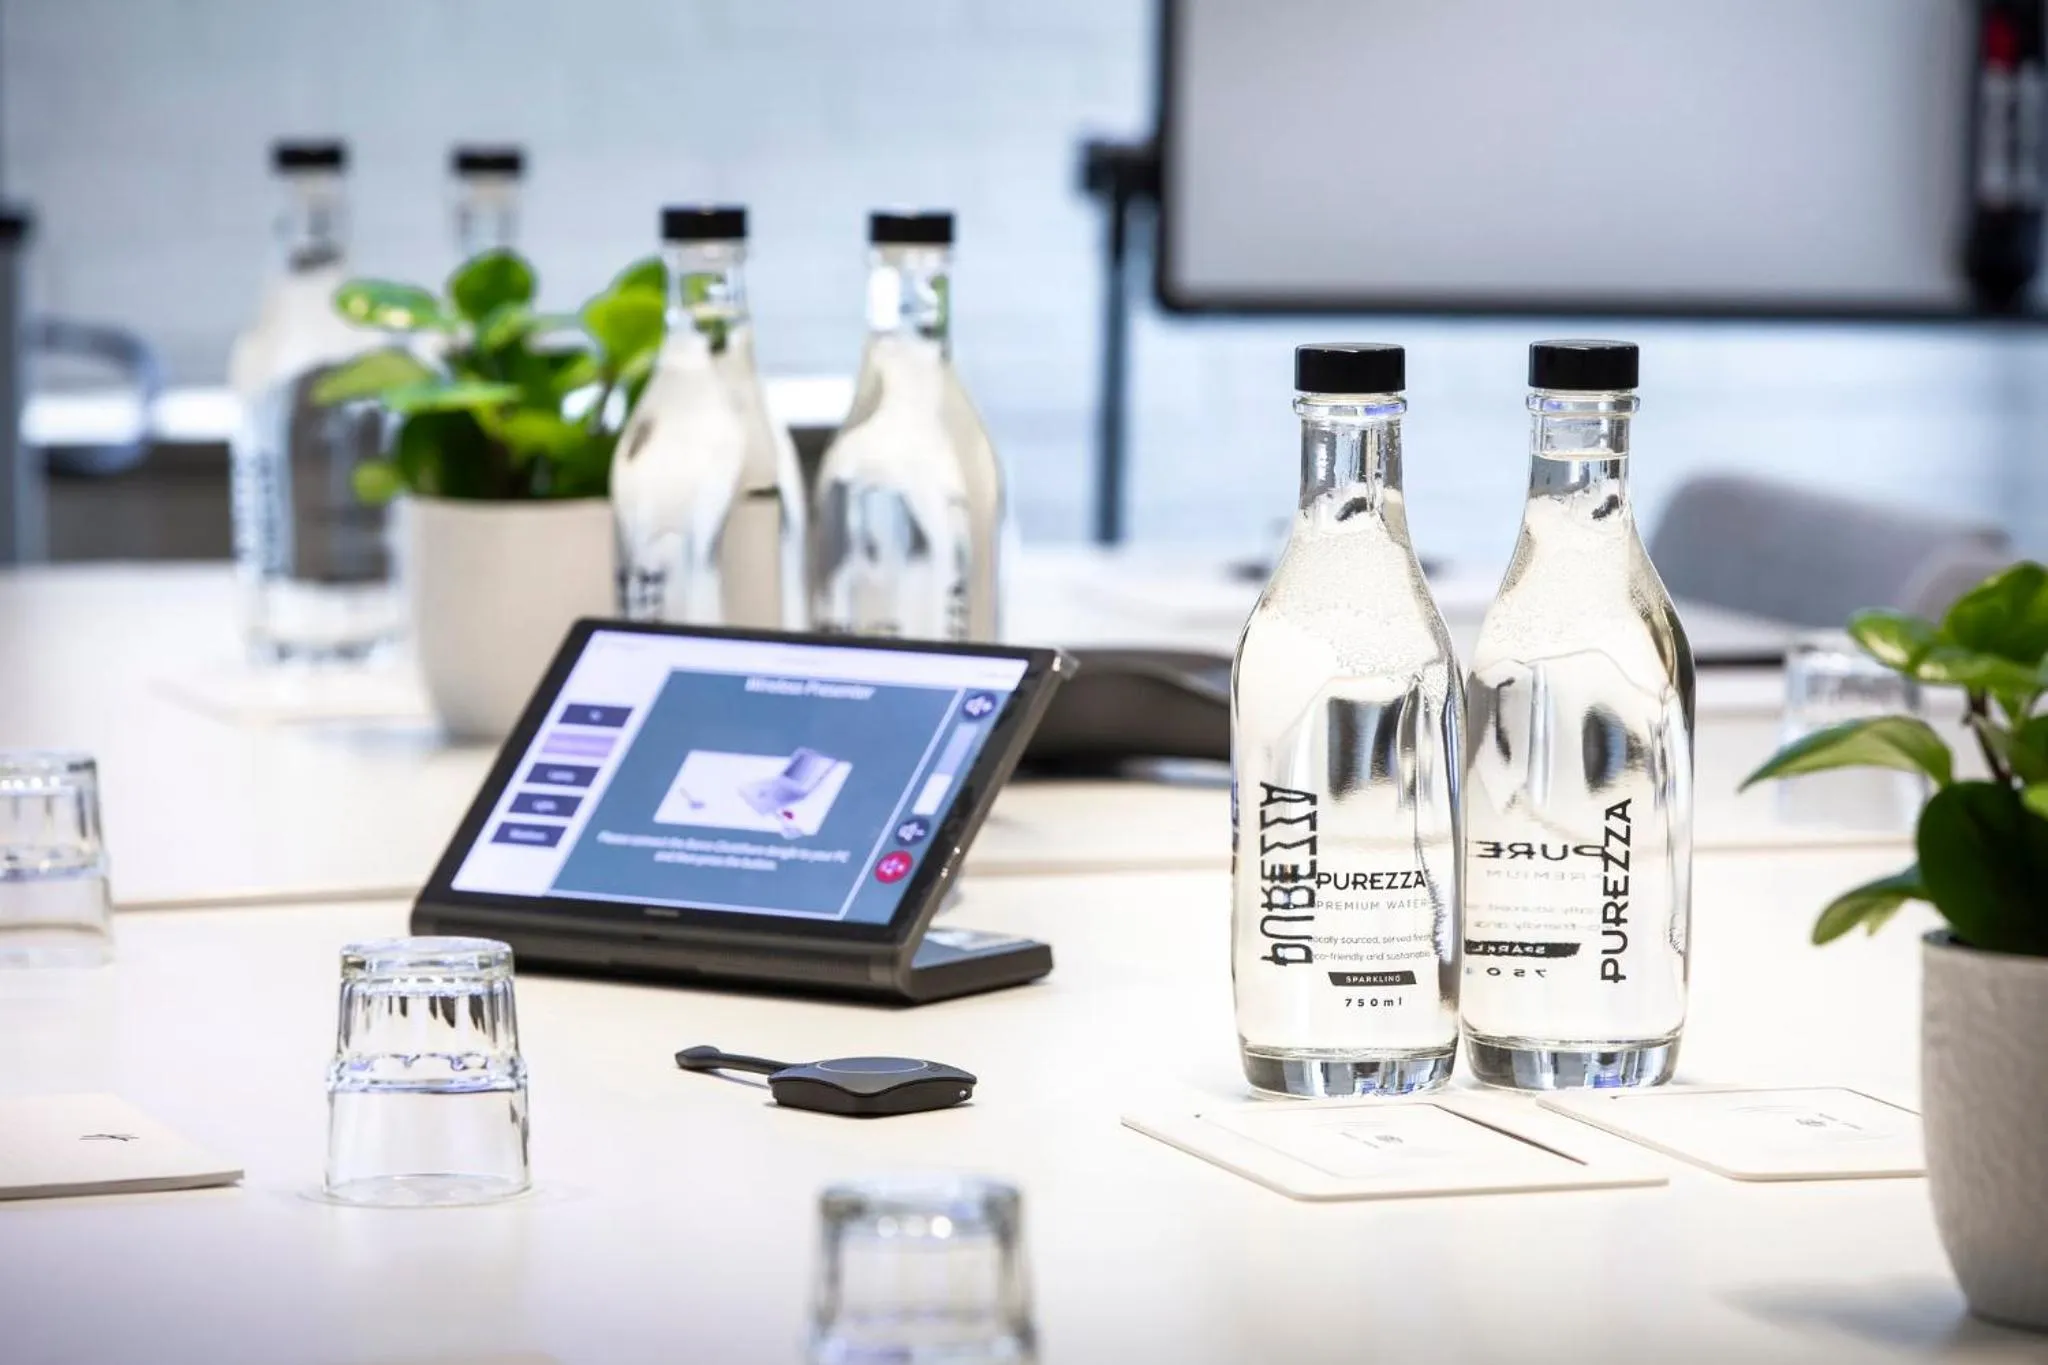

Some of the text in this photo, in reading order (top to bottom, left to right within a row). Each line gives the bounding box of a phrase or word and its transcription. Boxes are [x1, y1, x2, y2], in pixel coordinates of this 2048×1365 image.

[1316, 870, 1426, 890] PUREZZA
[1601, 798, 1632, 983] PUREZZA
[1316, 900, 1380, 911] PREMIUM
[1345, 975, 1401, 984] SPARKLING
